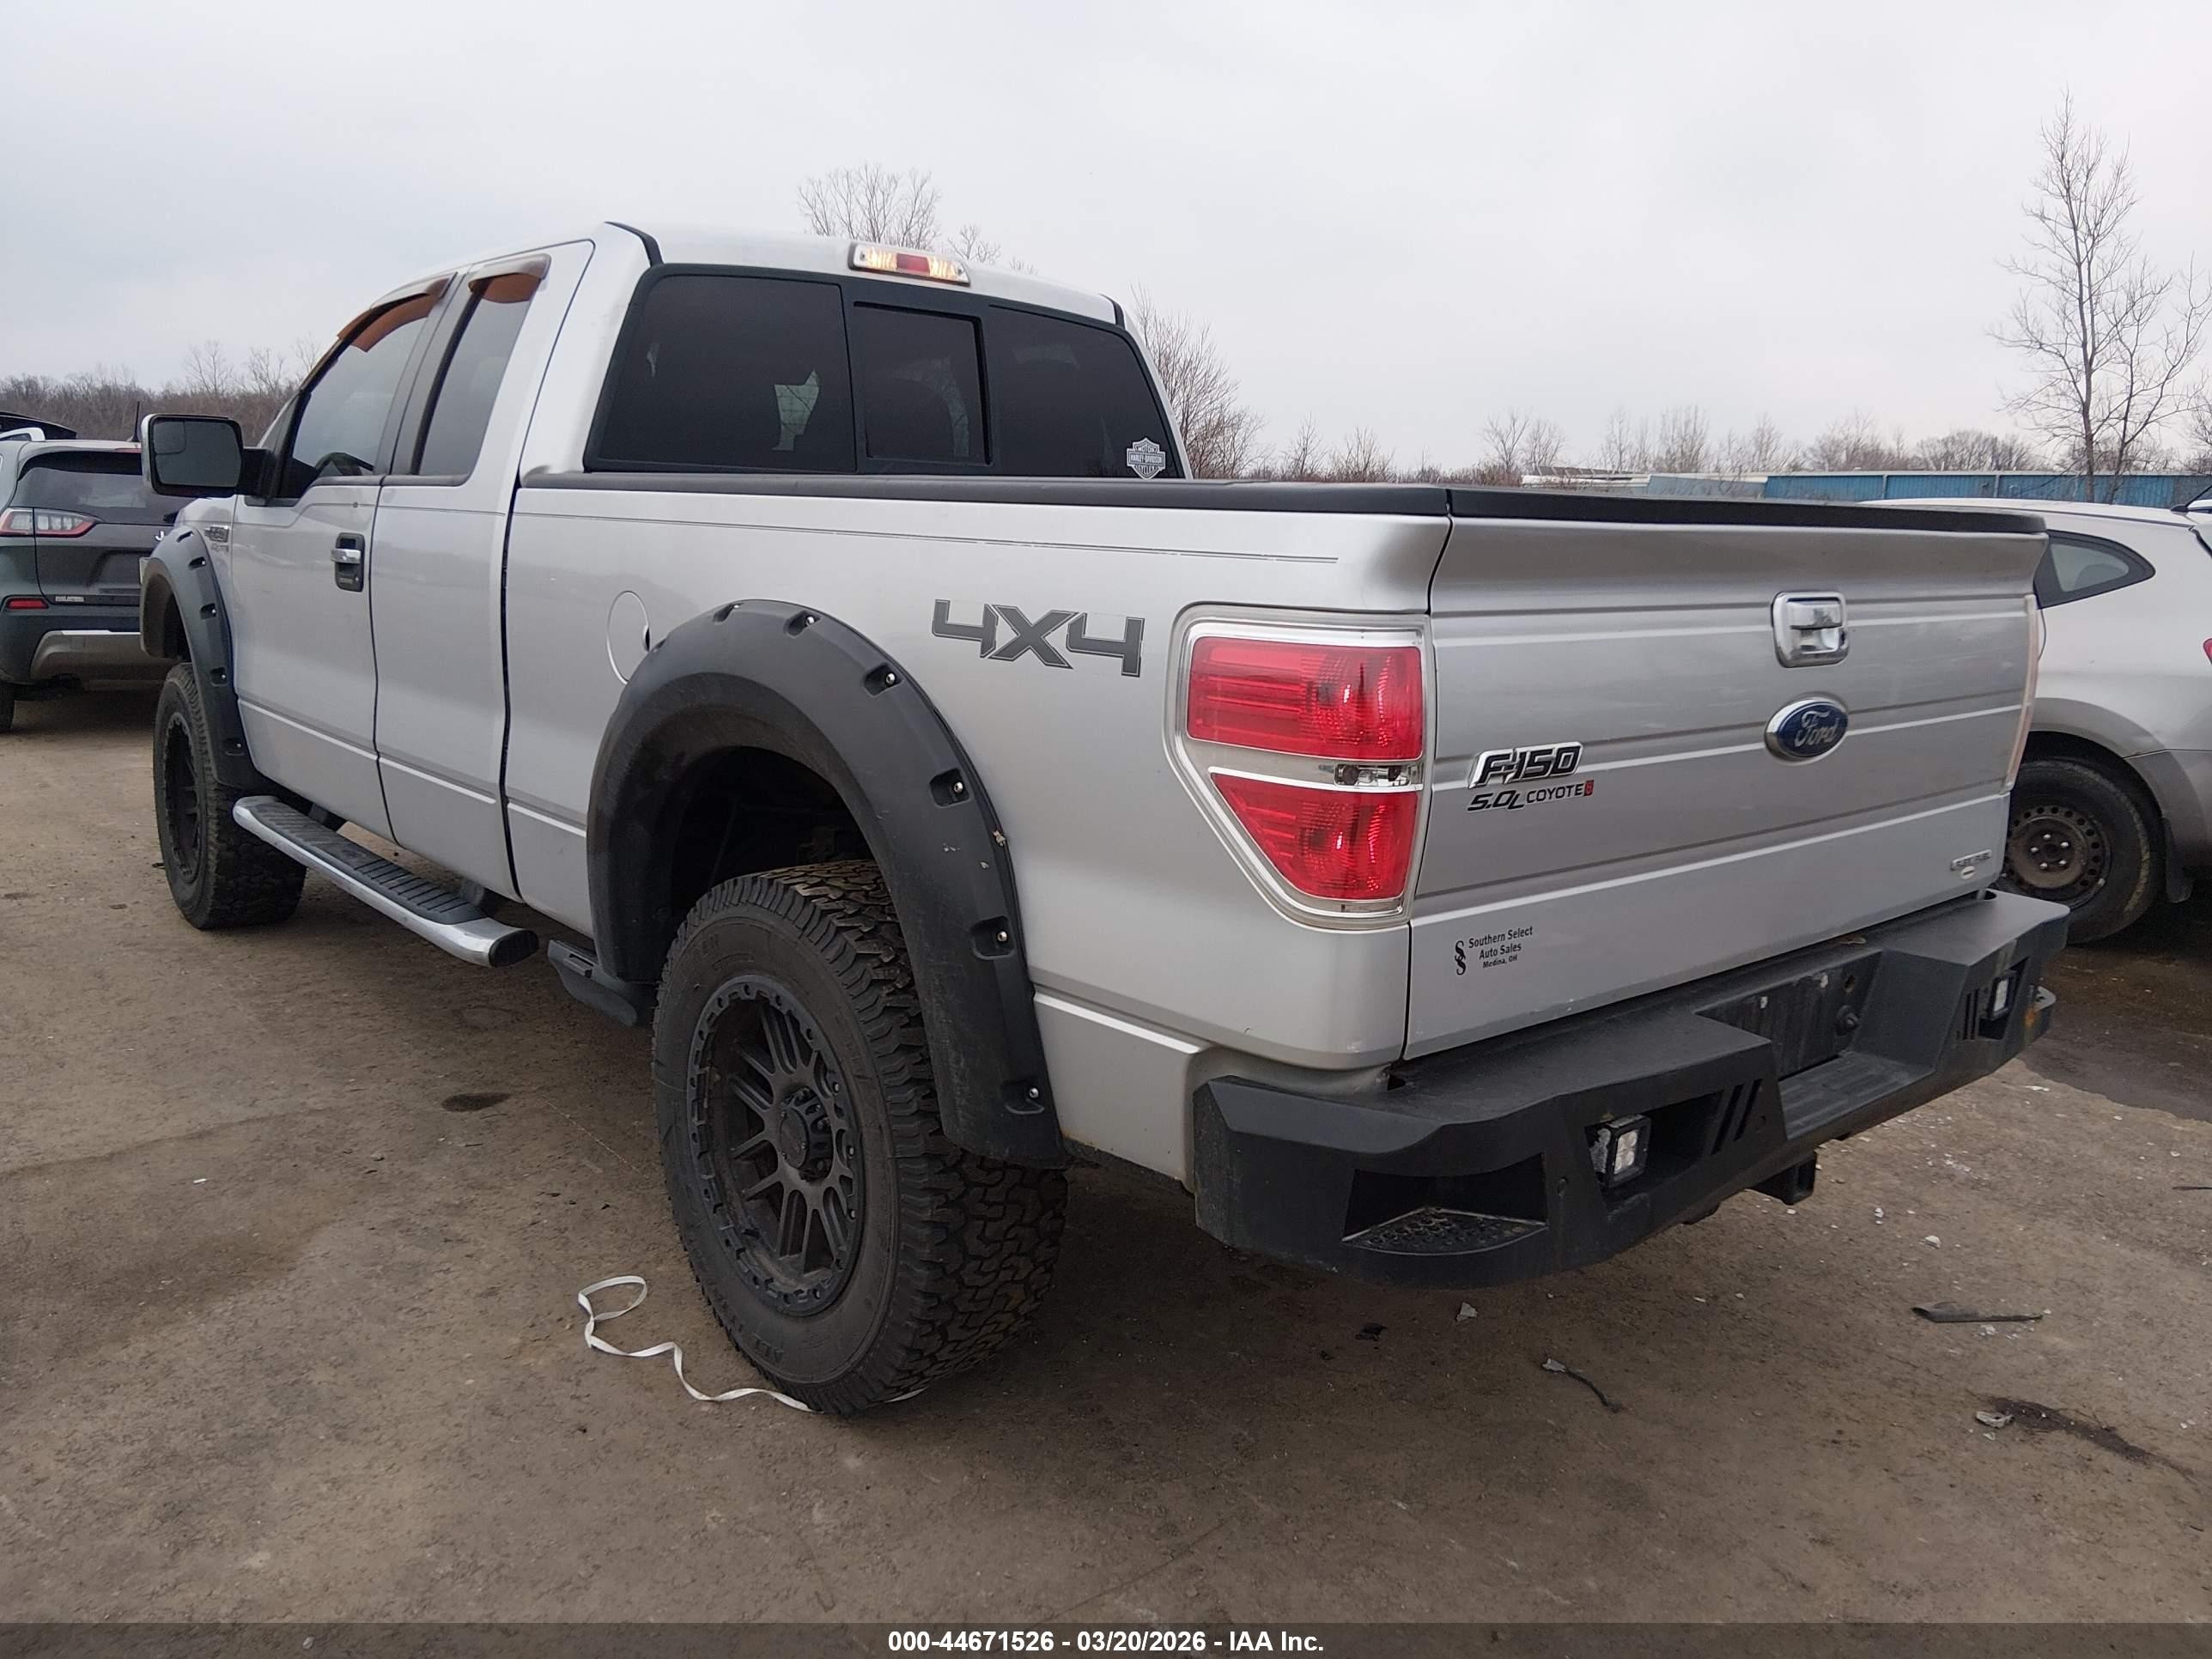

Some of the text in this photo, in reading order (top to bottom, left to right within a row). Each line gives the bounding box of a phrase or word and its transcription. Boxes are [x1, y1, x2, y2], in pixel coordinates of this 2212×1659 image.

[1794, 710, 1839, 747] Ford
[1468, 742, 1583, 789] F-150
[1468, 790, 1525, 811] 5.0L
[1526, 782, 1585, 804] COYOTE
[1468, 925, 1533, 949] Southern Select
[1479, 942, 1522, 960] Auto Sales
[1508, 954, 1518, 963] OH
